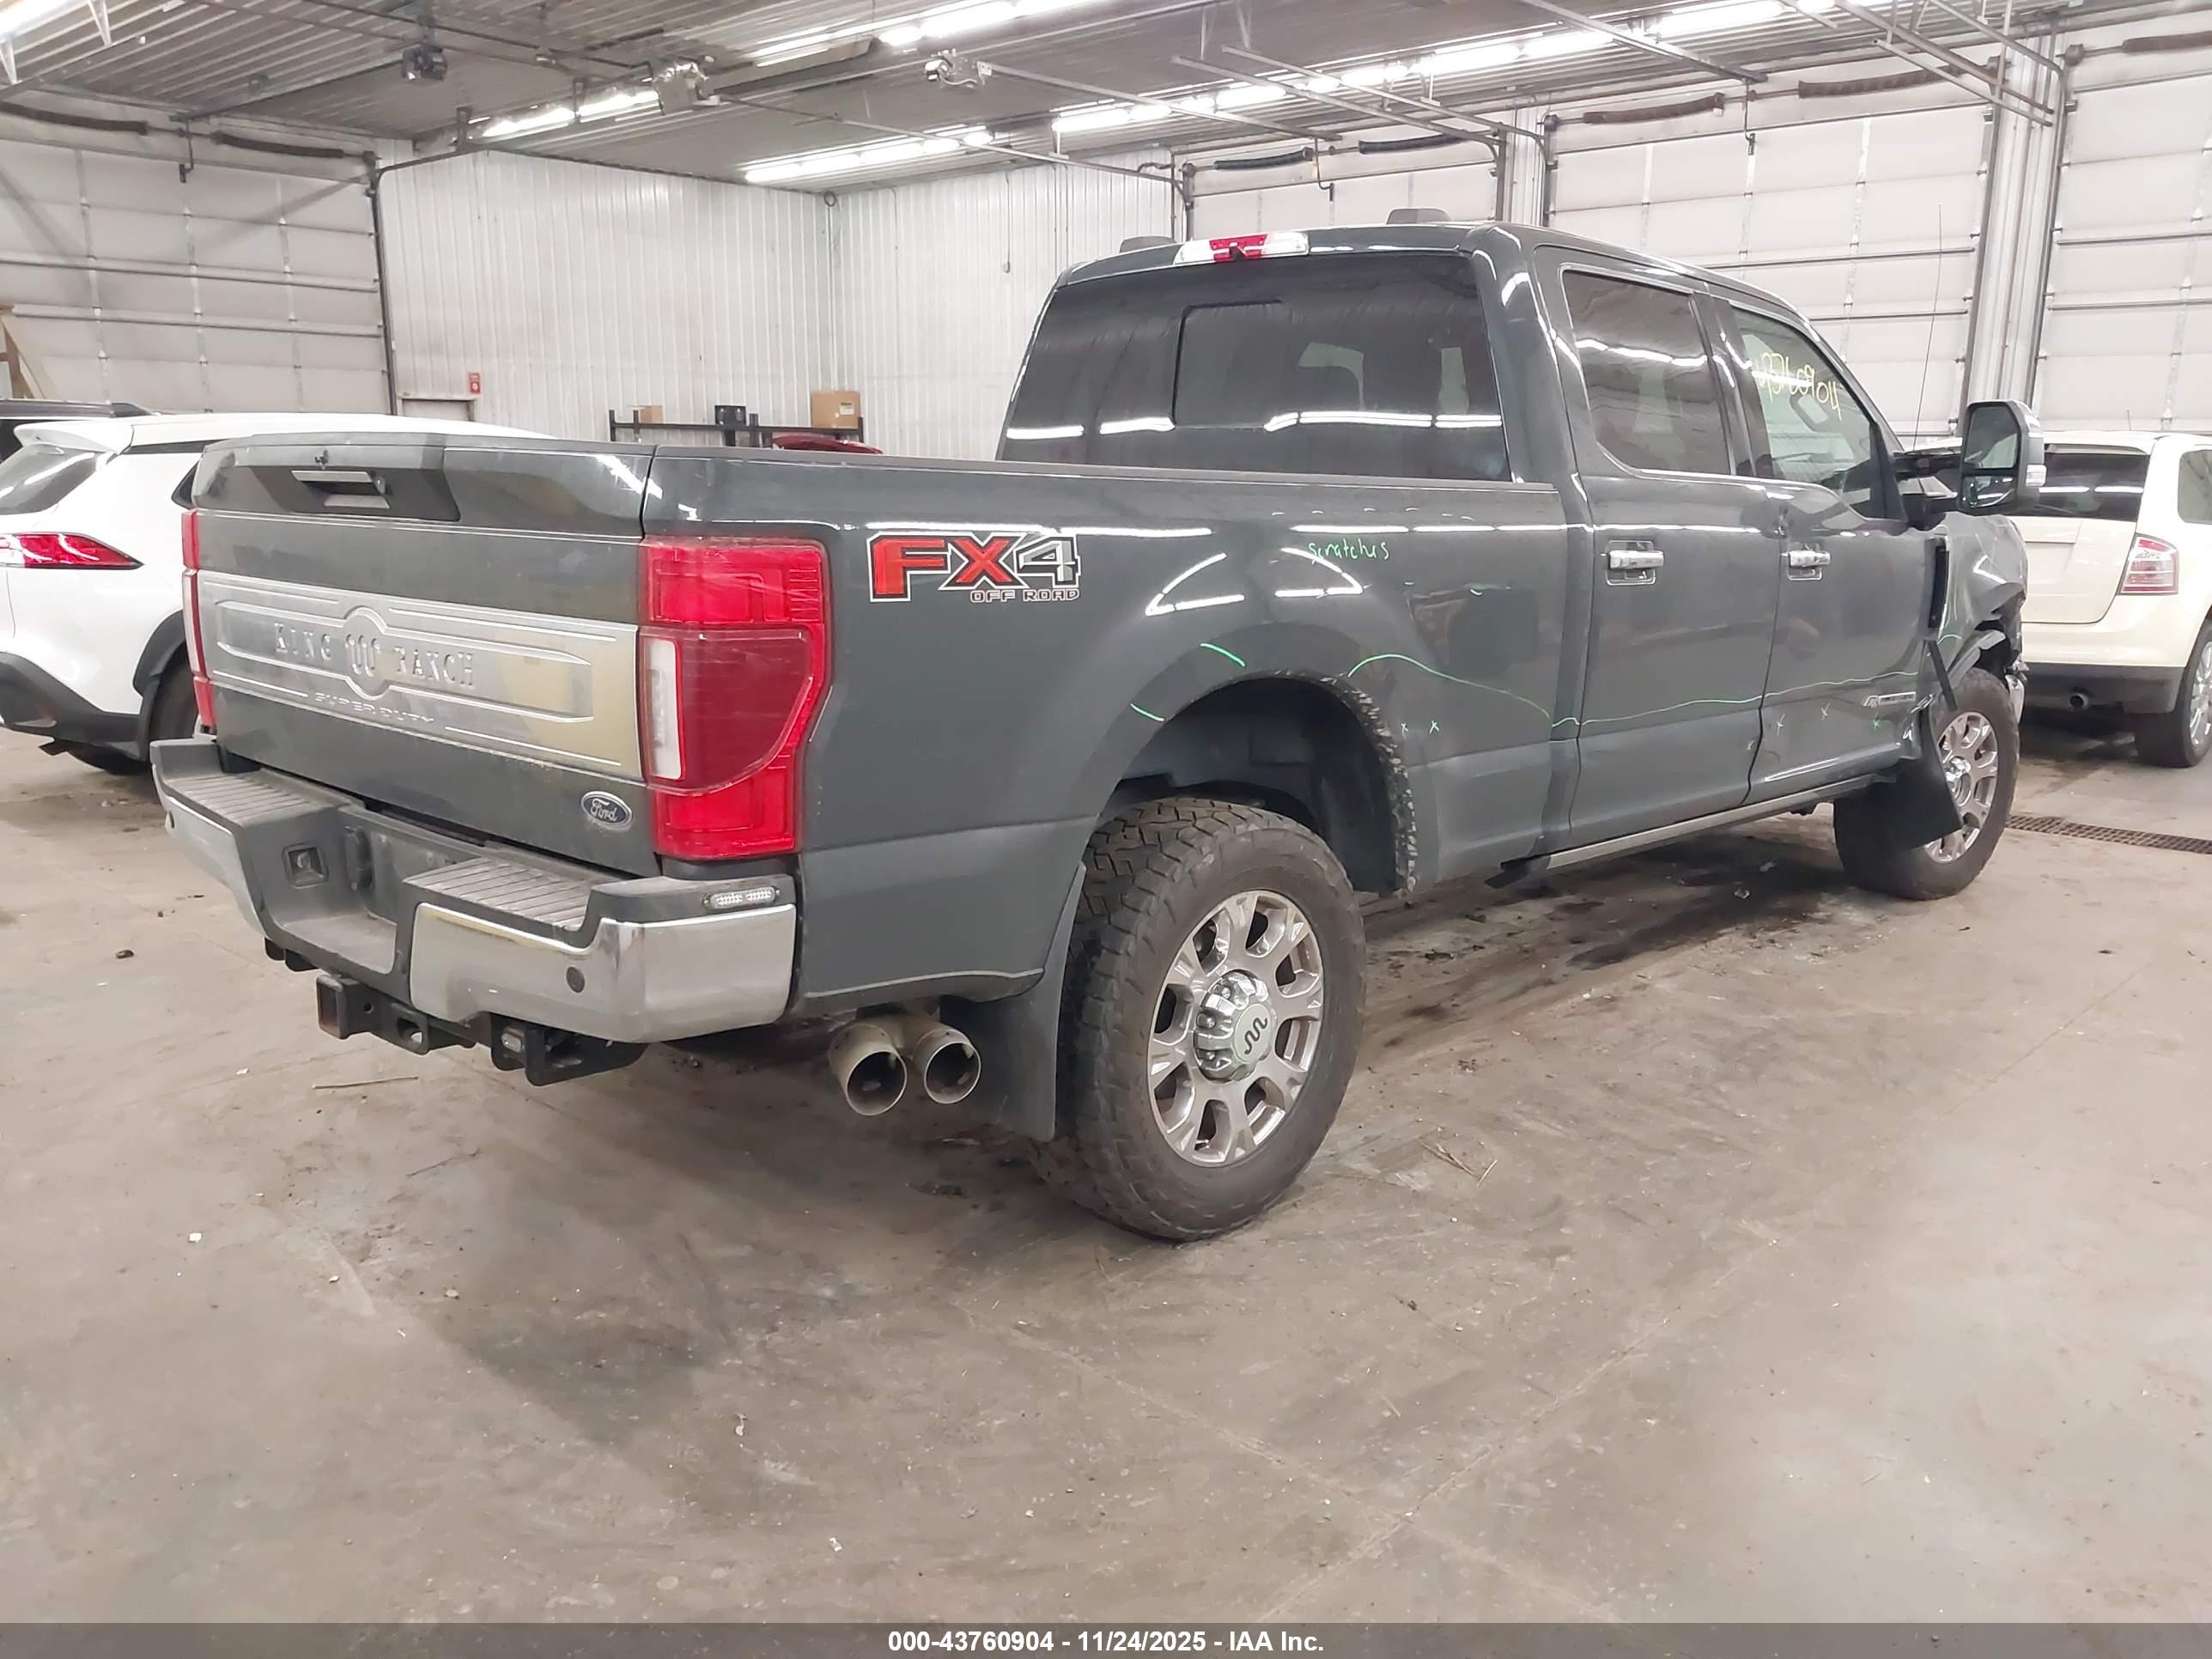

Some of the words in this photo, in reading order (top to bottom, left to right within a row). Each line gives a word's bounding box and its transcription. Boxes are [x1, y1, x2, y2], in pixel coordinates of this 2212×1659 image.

[866, 532, 1081, 602] FX4
[970, 588, 1016, 604] OFF
[1023, 588, 1080, 602] ROAD
[274, 622, 332, 660] KING
[393, 646, 474, 688] RANCH
[590, 798, 618, 822] Ford
